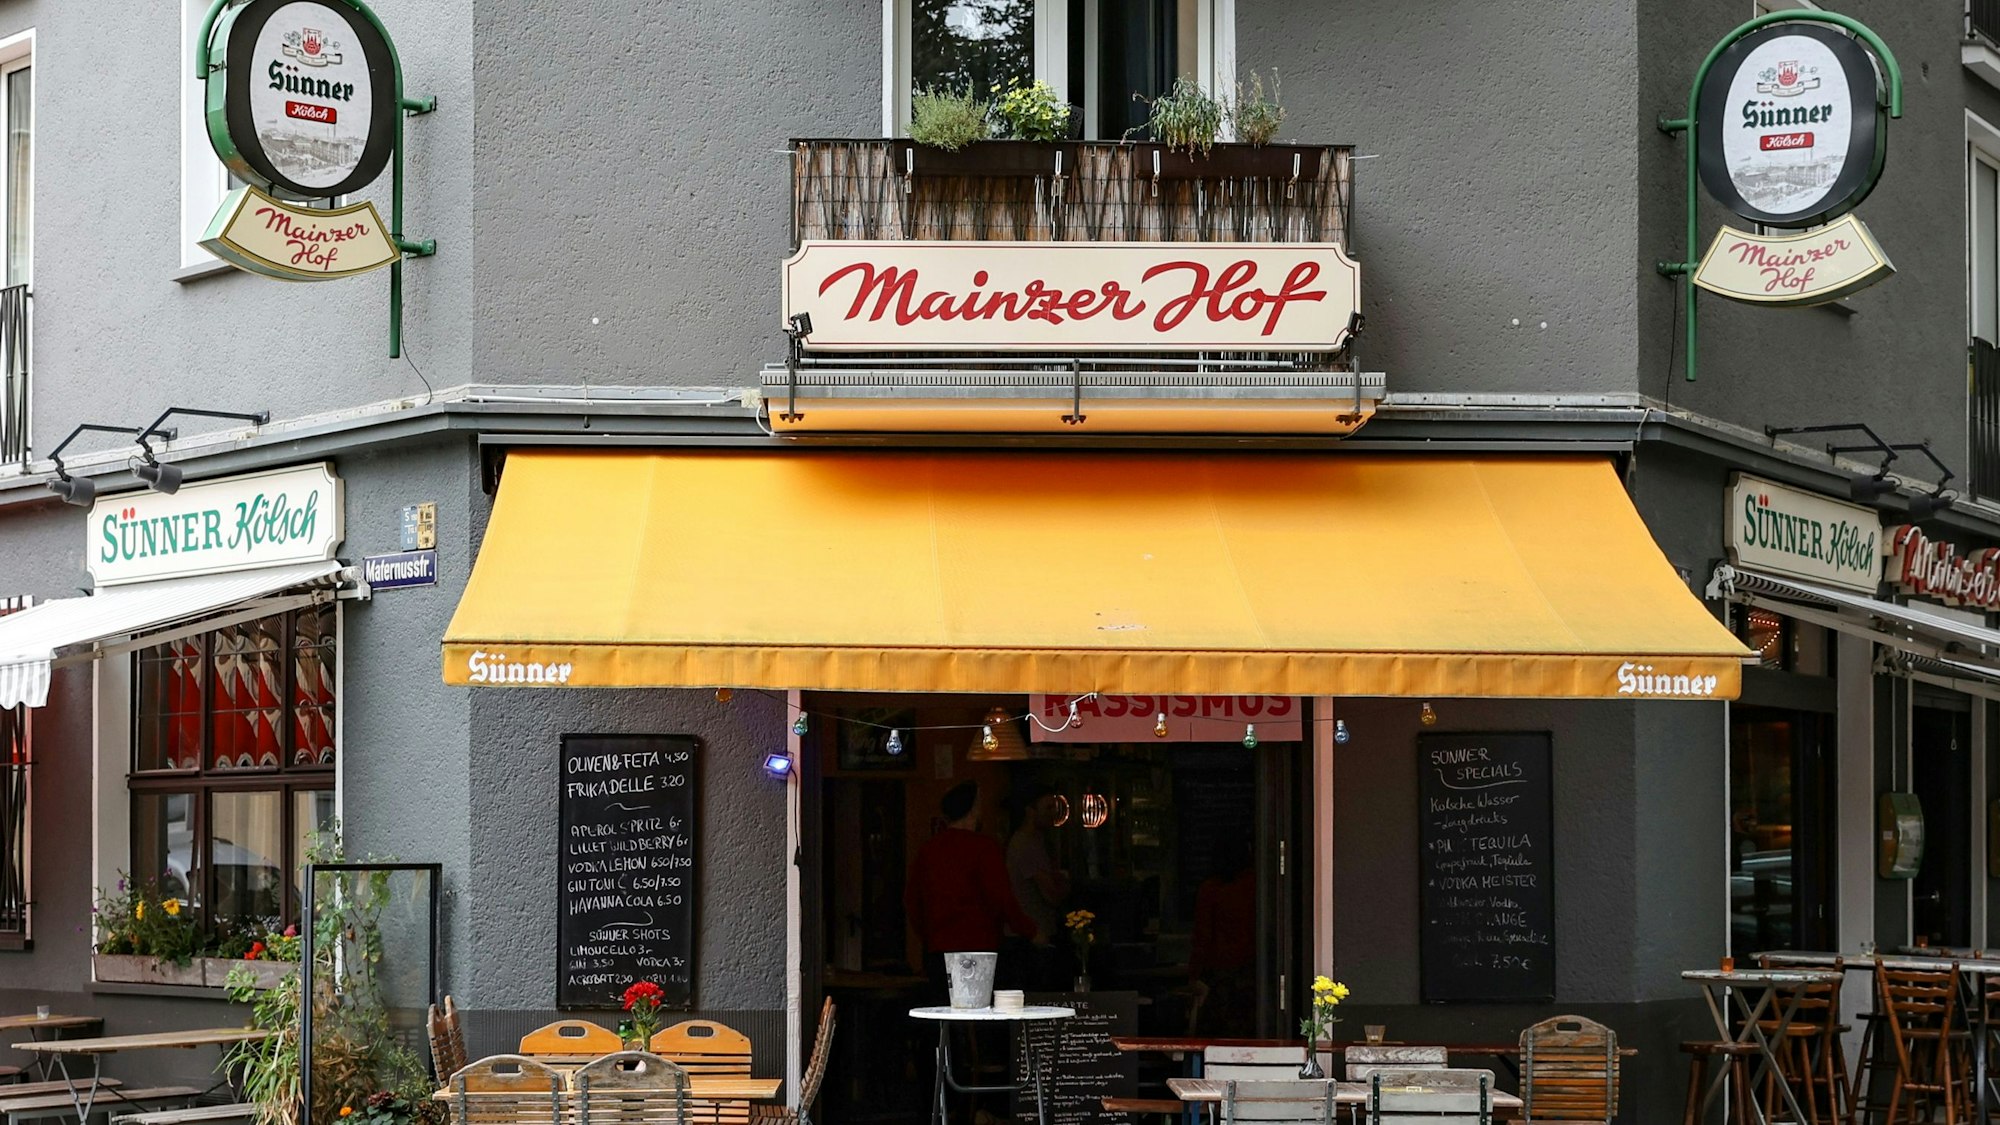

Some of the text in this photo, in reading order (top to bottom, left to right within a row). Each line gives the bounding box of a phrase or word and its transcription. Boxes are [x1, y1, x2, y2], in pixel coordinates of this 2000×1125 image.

[268, 60, 354, 102] Sünner
[291, 104, 328, 120] Kölsch
[1742, 100, 1833, 129] Sünner
[1766, 134, 1805, 148] Kölsch
[255, 207, 370, 243] Mainzer
[286, 240, 338, 270] Hof
[1729, 238, 1851, 267] Mainzer
[1760, 267, 1815, 293] Hof
[819, 261, 1327, 336] Mainzer Hof
[101, 489, 319, 563] SÜNNER Kölsch
[1744, 494, 1875, 577] SÜNNER Kölsch
[365, 555, 433, 583] Maternusstr.
[468, 650, 572, 683] Sünner
[1617, 661, 1717, 695] Sünner
[1045, 694, 1292, 718] RASSISMUS
[1456, 761, 1522, 780] SPECIALS
[567, 775, 655, 798] FRIKADELLE
[1470, 834, 1532, 851] TEQUILA
[568, 860, 607, 874] VODKA
[609, 856, 647, 873] LEMON
[568, 879, 587, 893] GIN
[570, 895, 624, 916] HAVANNA
[626, 894, 654, 907] COLA
[633, 929, 671, 941] SHOTS
